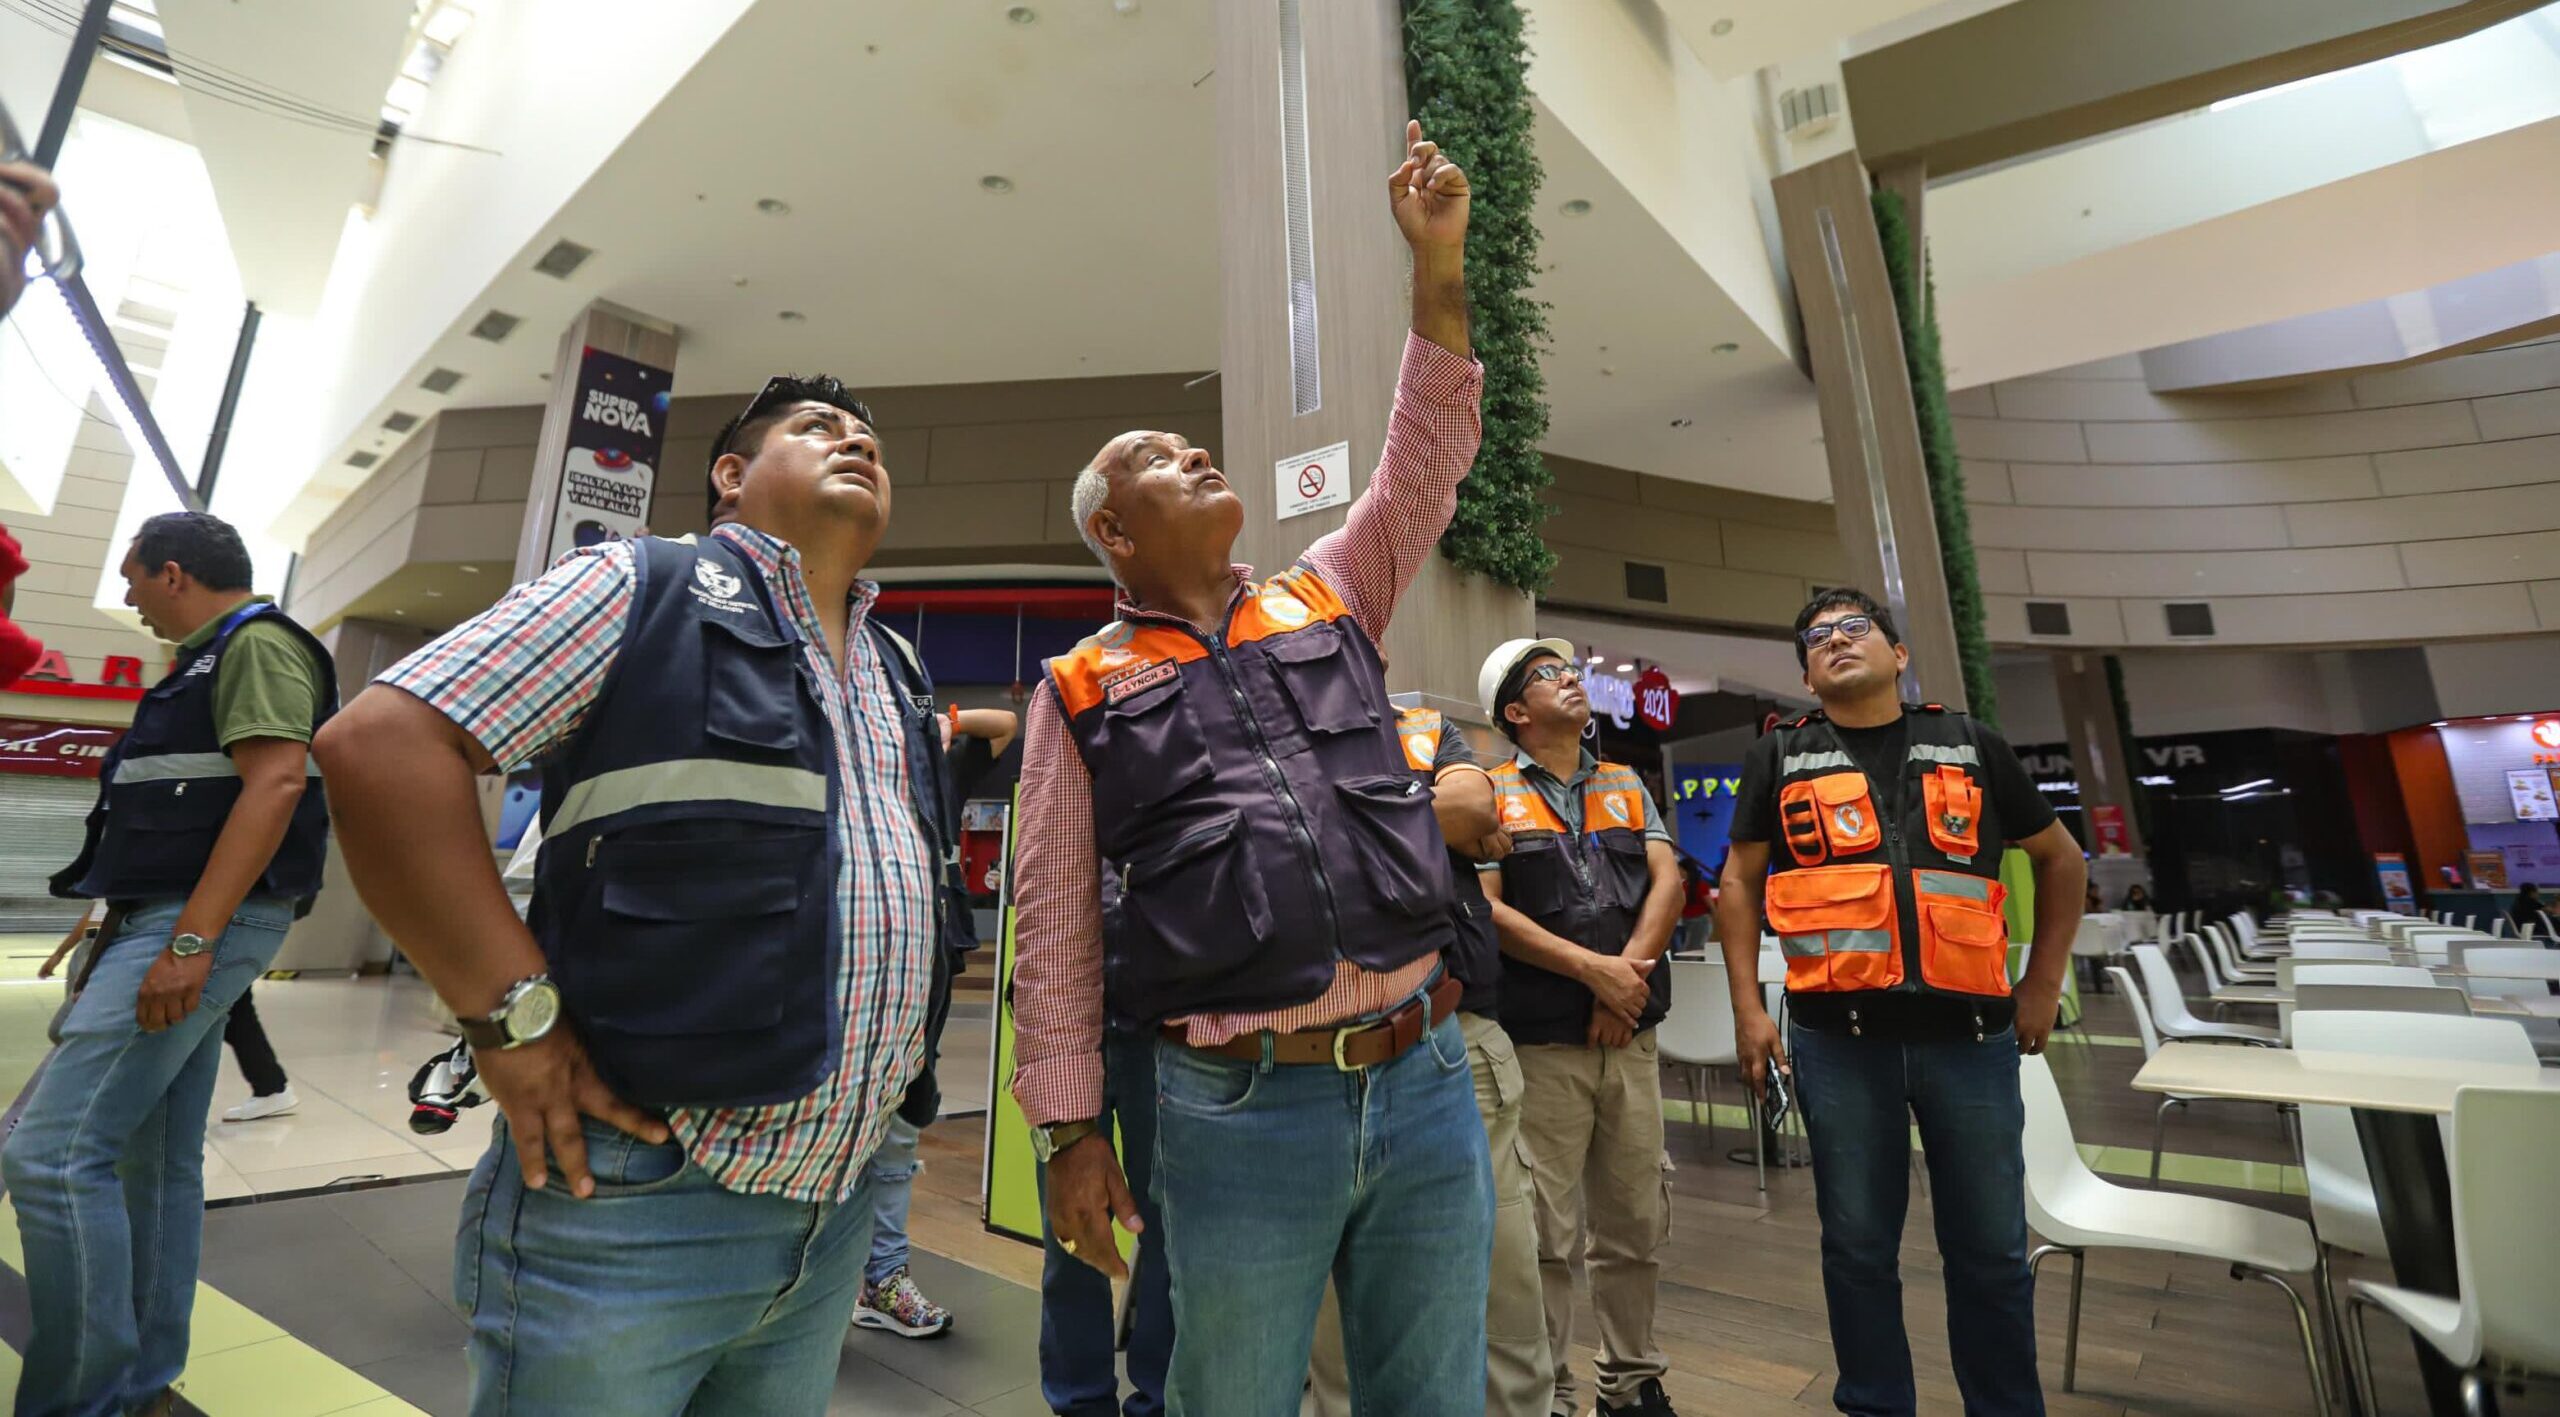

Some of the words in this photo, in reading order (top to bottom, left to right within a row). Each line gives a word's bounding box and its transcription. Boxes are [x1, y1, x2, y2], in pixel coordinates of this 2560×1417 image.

[588, 389, 640, 414] SUPER
[582, 402, 652, 437] NOVA
[575, 483, 637, 505] ESTRELLAS
[612, 483, 621, 492] A
[622, 485, 645, 498] LAS
[1125, 672, 1158, 692] LYNCH
[1643, 689, 1670, 725] 2021
[2145, 745, 2206, 767] VR
